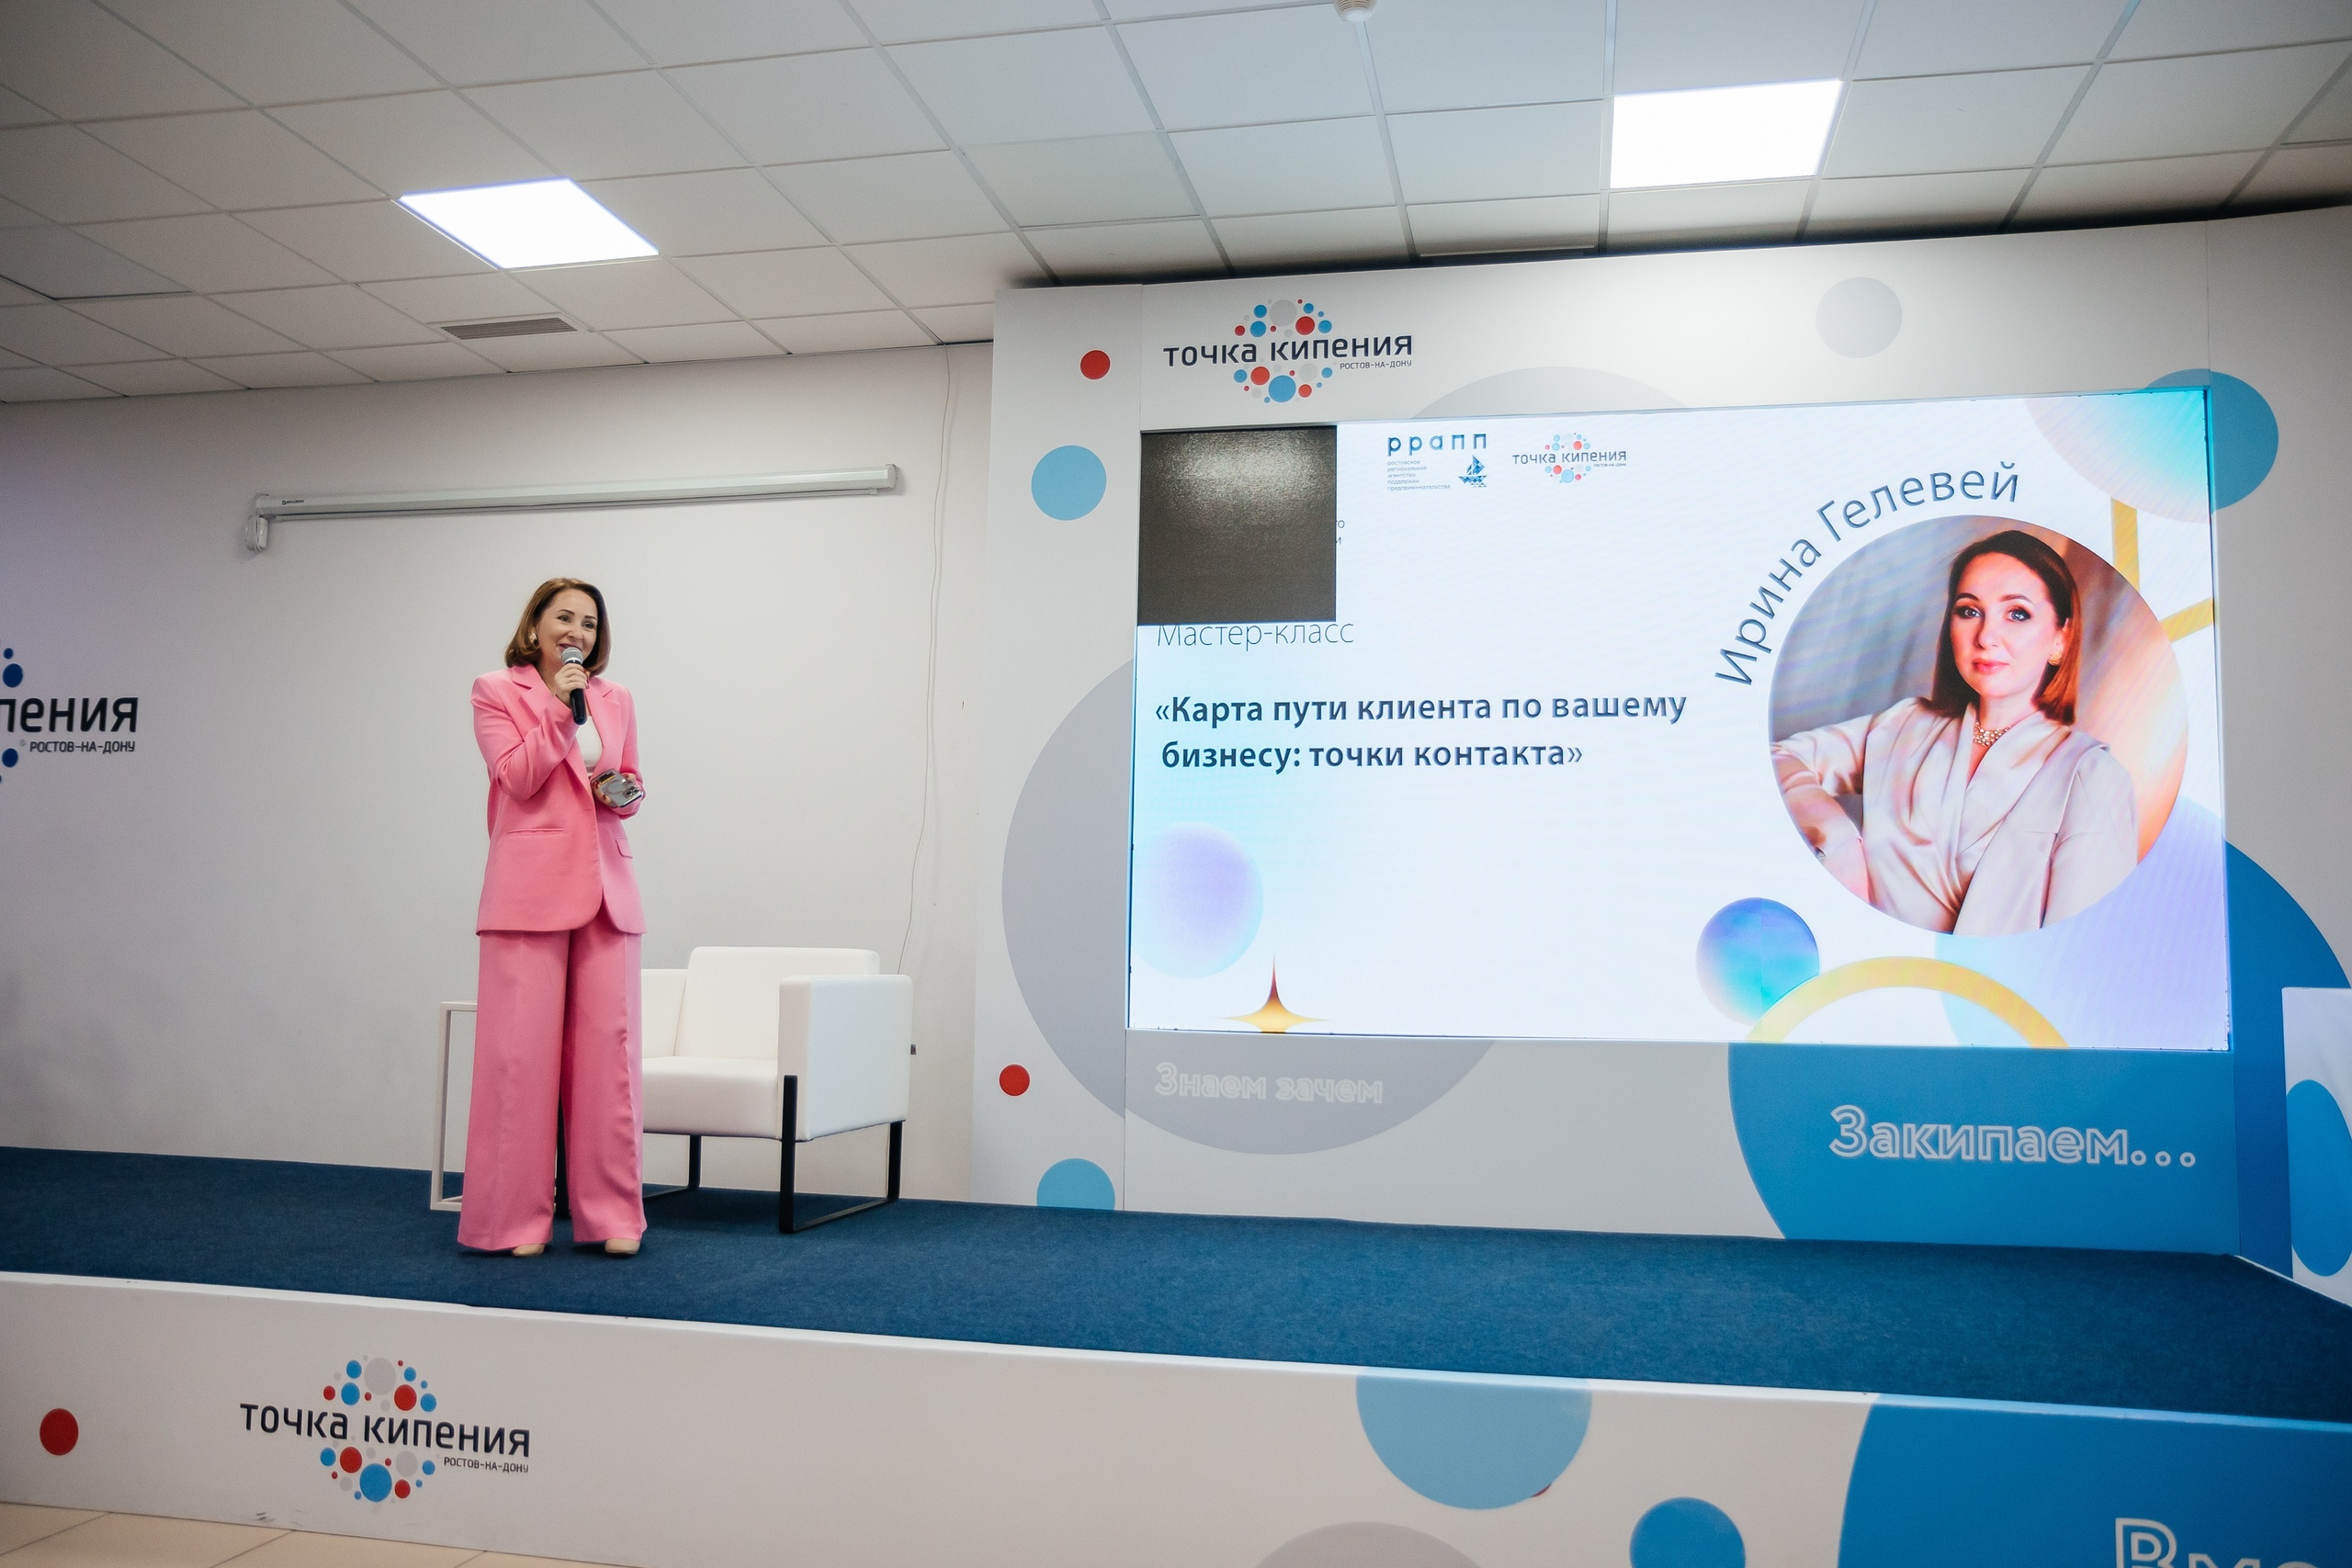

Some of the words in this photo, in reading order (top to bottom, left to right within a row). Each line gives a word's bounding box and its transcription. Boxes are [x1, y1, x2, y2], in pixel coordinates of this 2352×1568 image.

[1163, 344, 1257, 367] точка
[1271, 335, 1412, 361] кипения
[1340, 360, 1412, 369] РОСТОВ-НА-ДОНУ
[1387, 434, 1487, 457] ррапп
[1512, 454, 1556, 464] точка
[1562, 451, 1626, 462] кипения
[1714, 539, 1822, 685] Ирина
[1816, 461, 2018, 542] Гелевей
[1158, 623, 1353, 651] Мастер-класс
[1156, 696, 1262, 727] «Карта
[1272, 701, 1348, 727] пути
[1357, 698, 1491, 721] клиента
[1502, 700, 1542, 718] по
[1552, 695, 1687, 725] вашему
[29, 740, 135, 754] РОСТОВ-НА-ДОНУ
[1162, 741, 1300, 774] бизнесу:
[1309, 747, 1403, 768] точки
[1415, 743, 1582, 766] контакта»
[1155, 1062, 1267, 1100] Знаем
[1275, 1077, 1383, 1103] зачем
[1829, 1104, 2196, 1168] Закипаем...
[240, 1403, 348, 1439] точка
[364, 1415, 530, 1457] кипения
[444, 1457, 529, 1473] РОСТОВ-НА-ДОНУ
